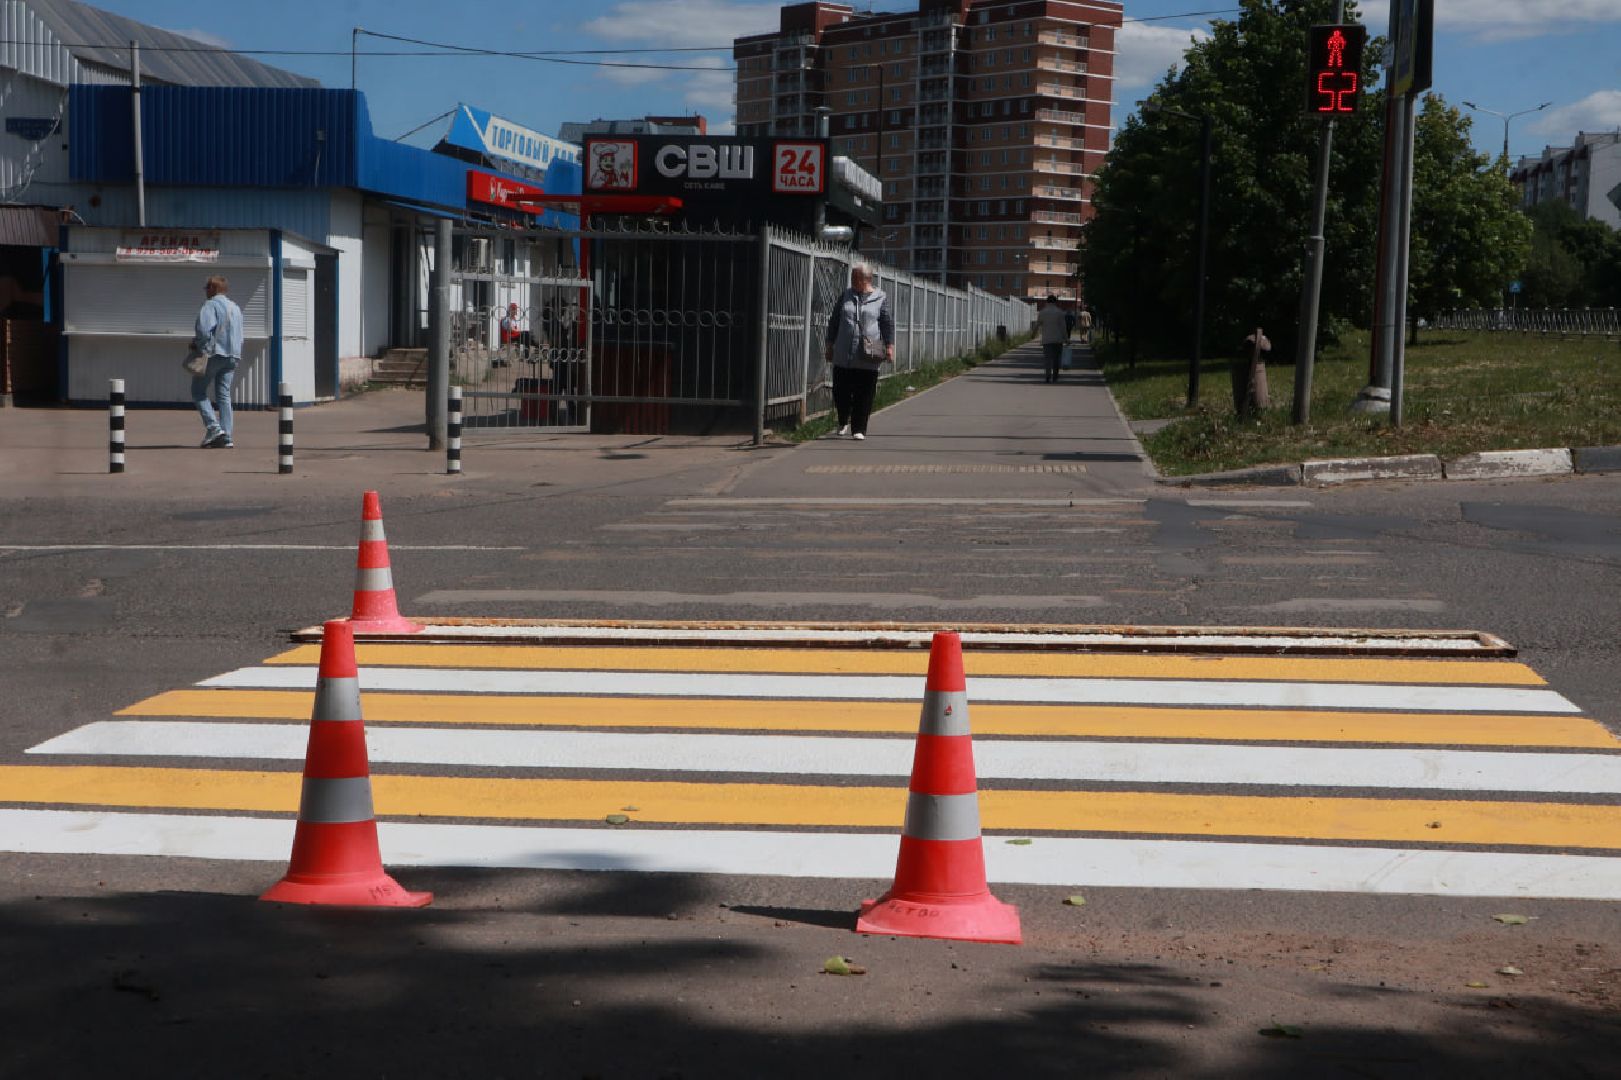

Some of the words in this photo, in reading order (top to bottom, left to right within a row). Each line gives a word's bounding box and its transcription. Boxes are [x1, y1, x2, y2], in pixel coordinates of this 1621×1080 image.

[1317, 71, 1357, 111] 52
[491, 124, 550, 164] ТОРГОВЫЙ
[655, 144, 753, 179] СВШ
[780, 149, 816, 175] 24
[780, 175, 816, 187] ЧАСА
